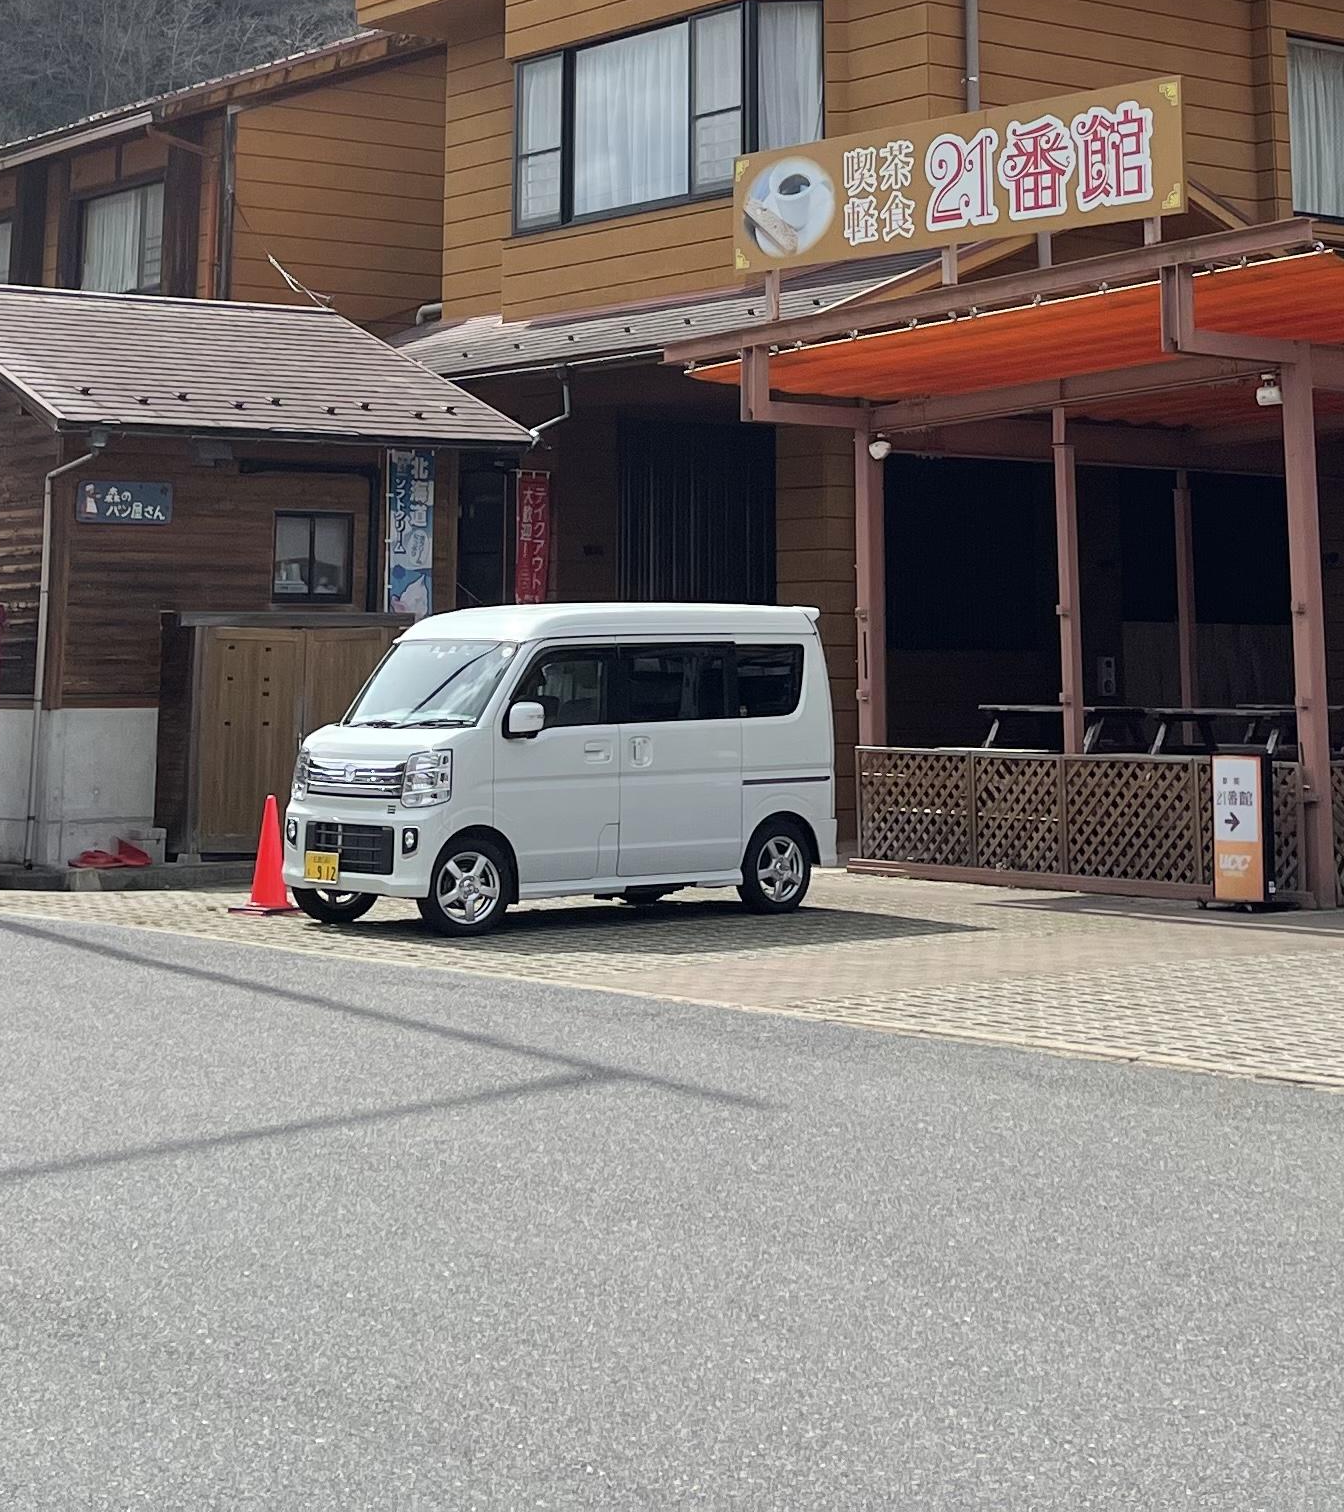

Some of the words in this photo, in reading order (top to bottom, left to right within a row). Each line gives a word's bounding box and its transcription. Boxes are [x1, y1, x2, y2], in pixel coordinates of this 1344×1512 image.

[843, 140, 915, 196] 喫茶
[926, 101, 1153, 231] 21番館
[843, 190, 915, 246] 軽食
[104, 487, 132, 503] 森の
[106, 502, 166, 521] パン屋さん
[392, 478, 406, 554] ソフトクリーム
[409, 456, 429, 528] 北海道
[531, 488, 547, 589] テイクアウト
[1219, 853, 1252, 871] UCC
